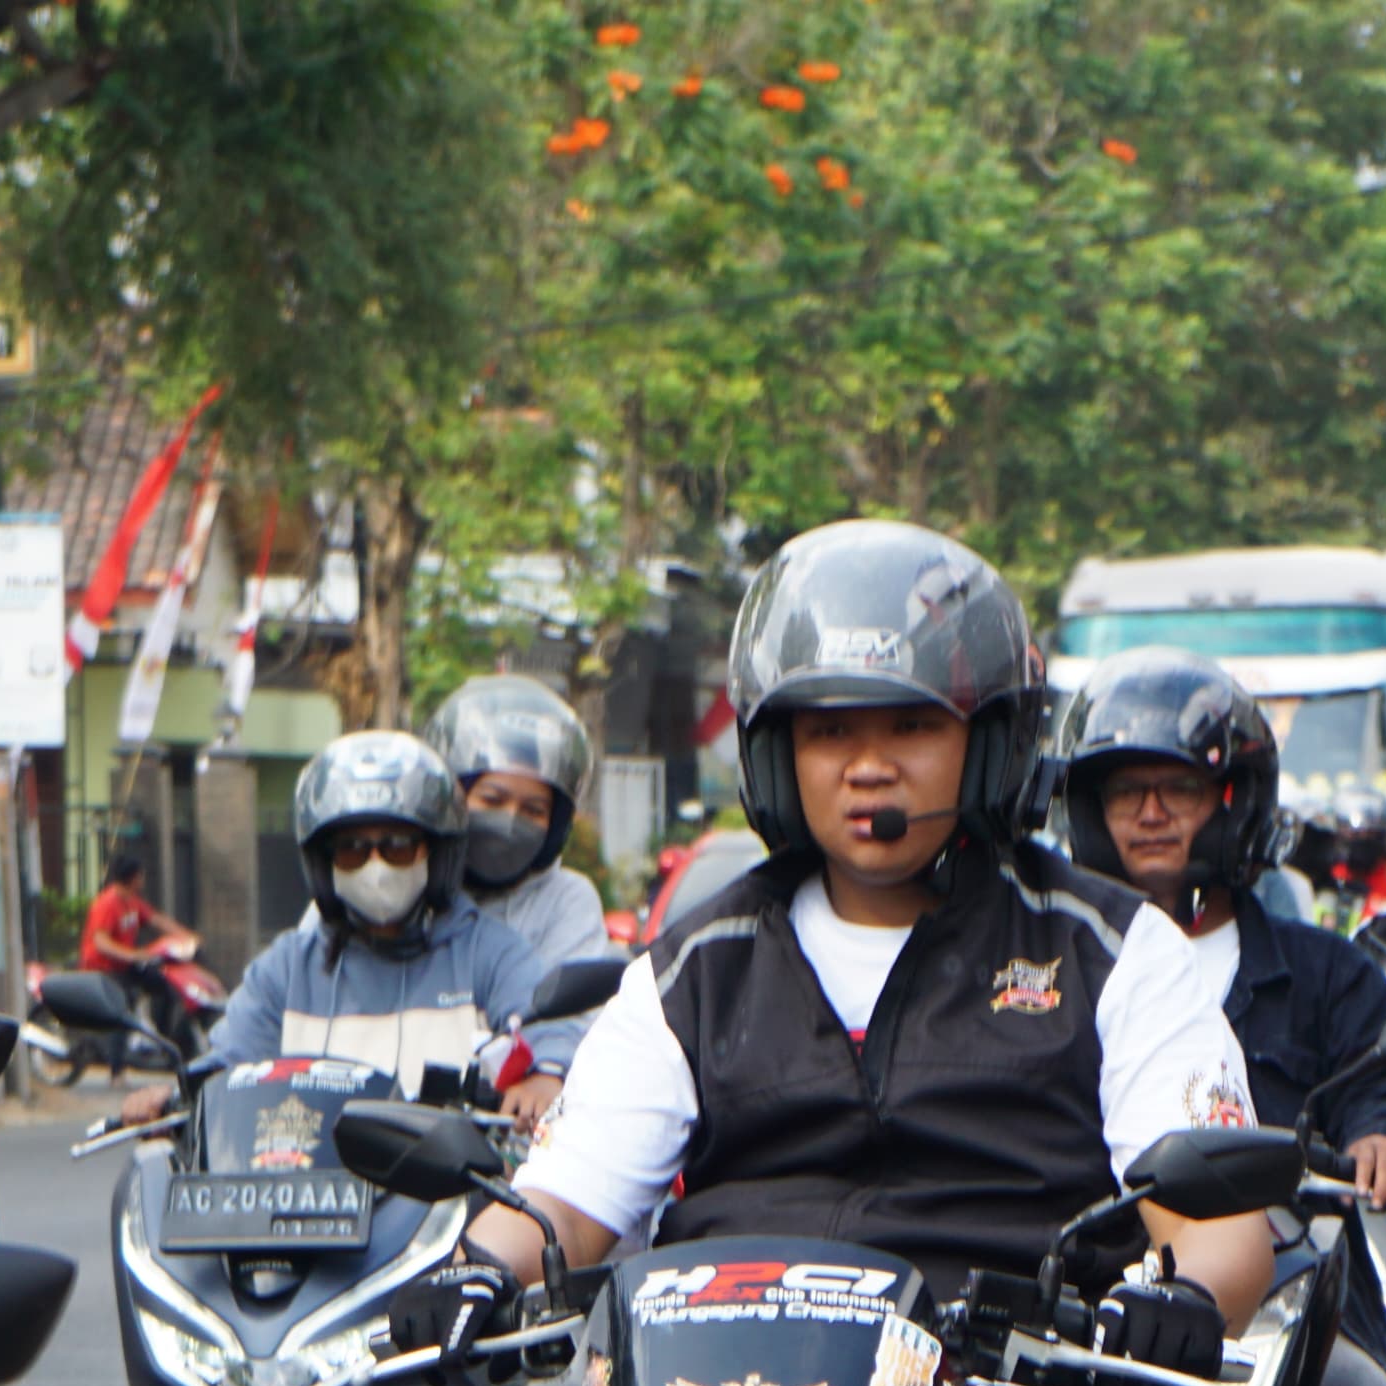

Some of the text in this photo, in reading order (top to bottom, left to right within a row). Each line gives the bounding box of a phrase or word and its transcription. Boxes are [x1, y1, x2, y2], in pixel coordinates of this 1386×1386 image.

[177, 1184, 211, 1214] AG
[632, 1293, 686, 1316] Honda
[766, 1287, 805, 1303] Club
[810, 1288, 897, 1314] Indonesia
[785, 1301, 884, 1326] Chapter
